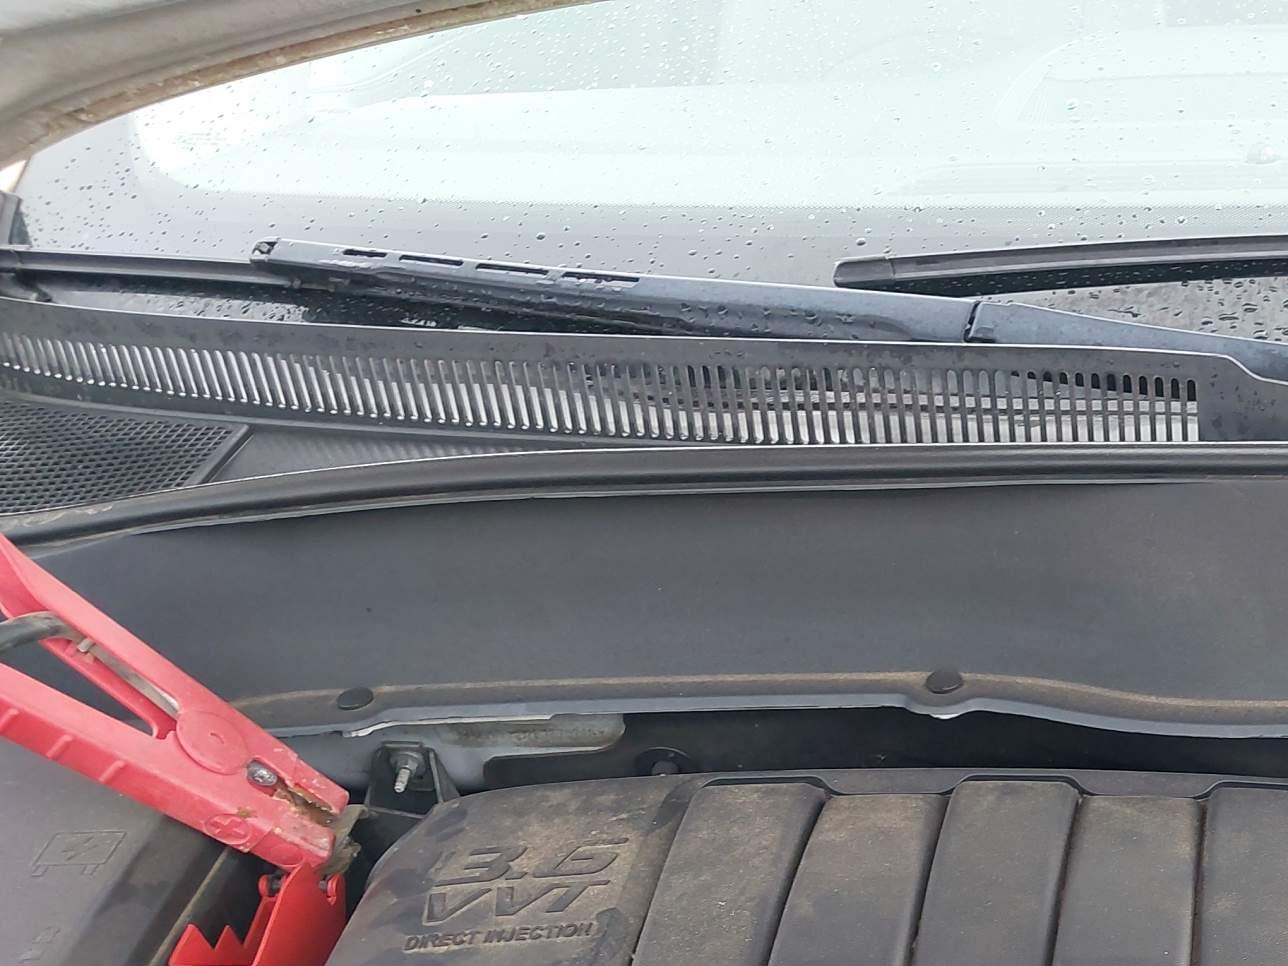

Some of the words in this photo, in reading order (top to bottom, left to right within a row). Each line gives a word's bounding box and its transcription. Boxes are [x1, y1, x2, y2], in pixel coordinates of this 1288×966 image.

[435, 837, 628, 887] 3.6
[423, 880, 610, 926] VVT
[404, 930, 481, 952] DIRECT
[483, 922, 594, 944] INJECTION
